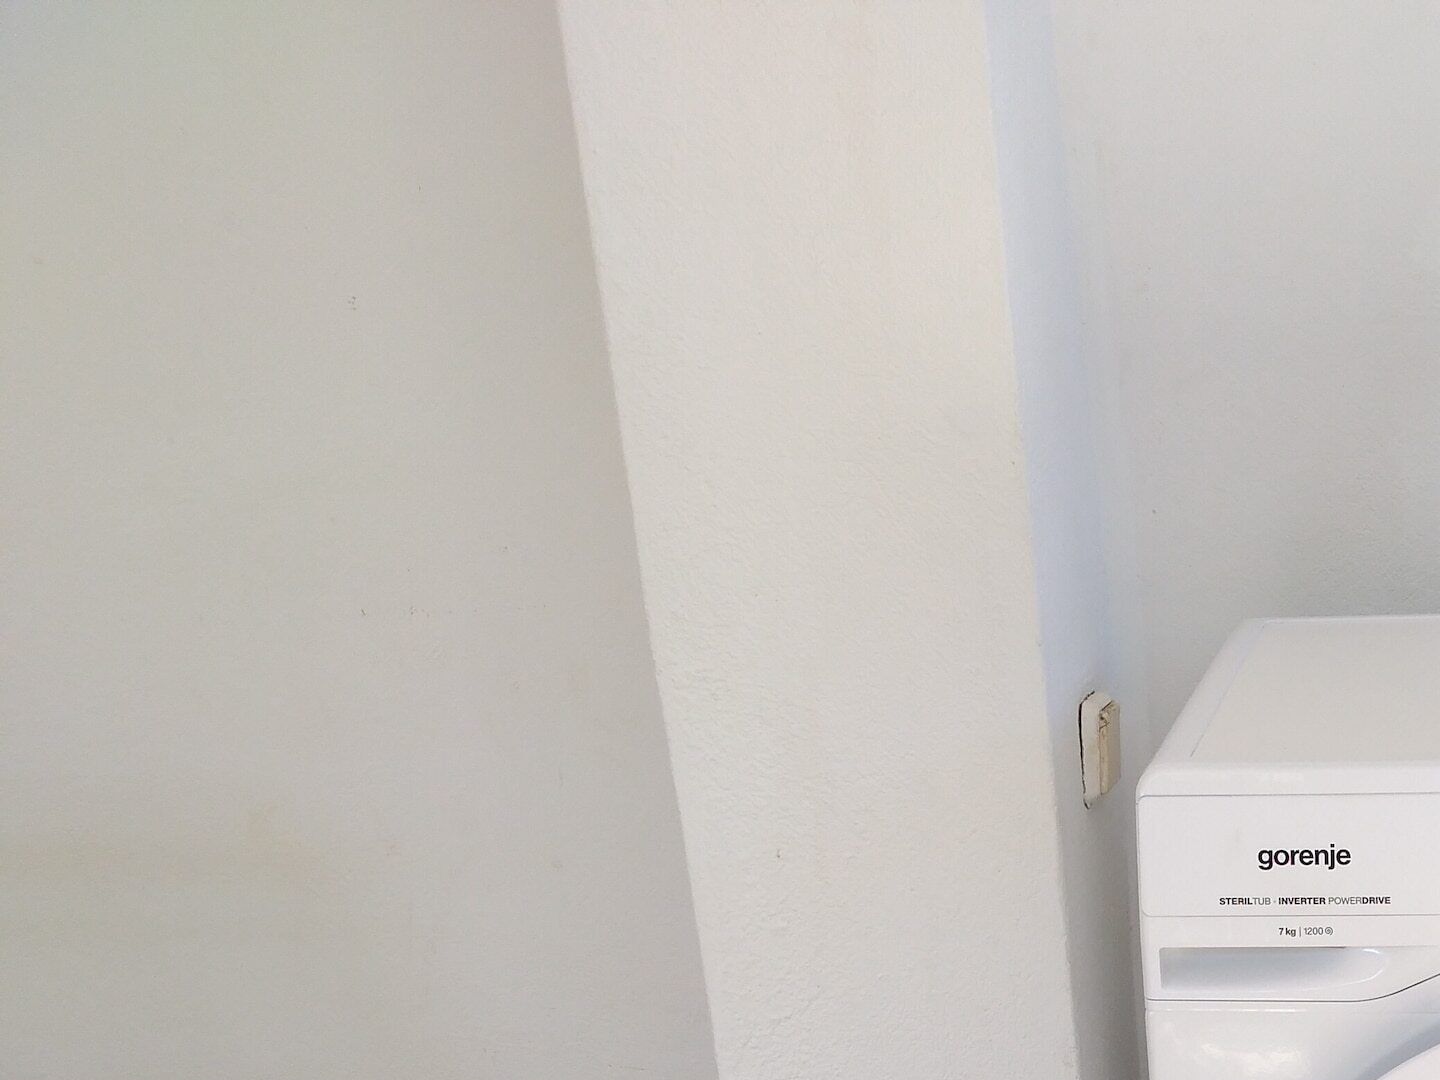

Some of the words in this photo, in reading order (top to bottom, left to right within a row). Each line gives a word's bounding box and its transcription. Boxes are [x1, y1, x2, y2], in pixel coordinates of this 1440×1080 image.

[1258, 844, 1351, 870] gorenje
[1219, 897, 1271, 905] STERILTUB
[1278, 897, 1326, 905] INVERTER
[1328, 896, 1391, 905] POWERDRIVE
[1286, 927, 1296, 937] kg
[1304, 927, 1324, 935] 1200
